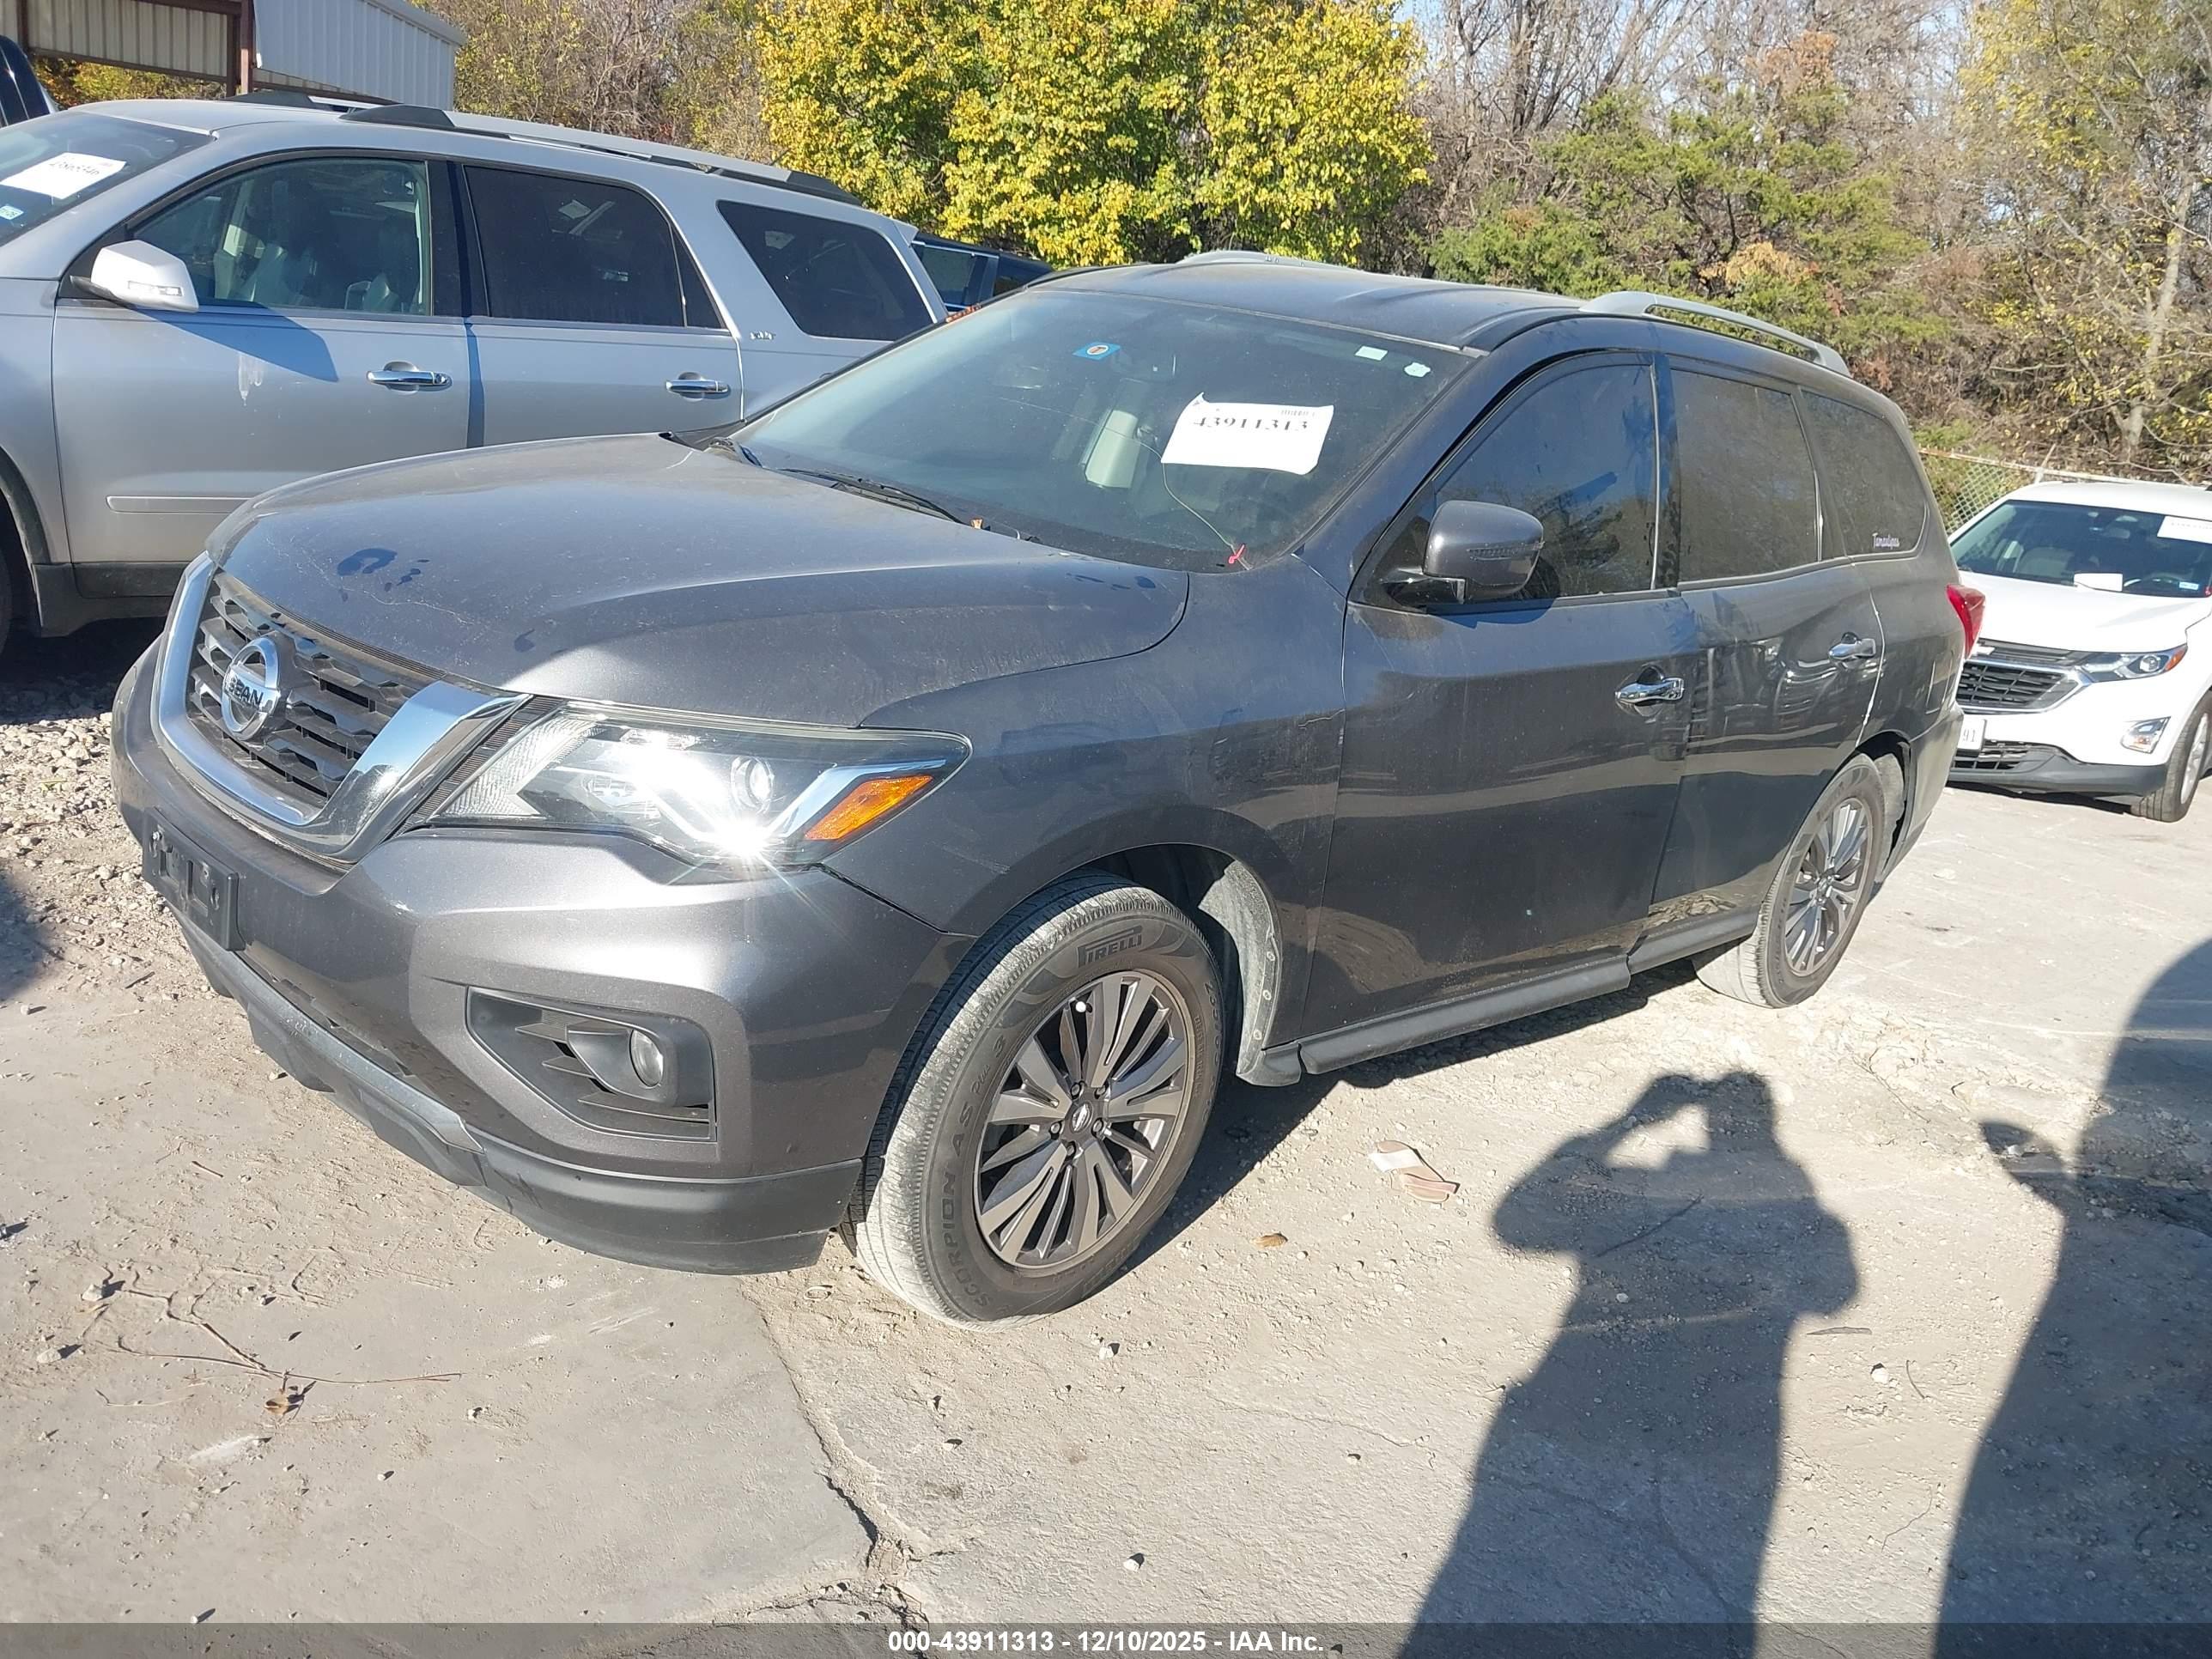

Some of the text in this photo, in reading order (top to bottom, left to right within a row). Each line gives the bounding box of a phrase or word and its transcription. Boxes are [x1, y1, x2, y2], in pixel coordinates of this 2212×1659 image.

[1194, 416, 1308, 431] 43911313
[1077, 924, 1143, 969] PIRELLI
[941, 1170, 991, 1308] SCORPION
